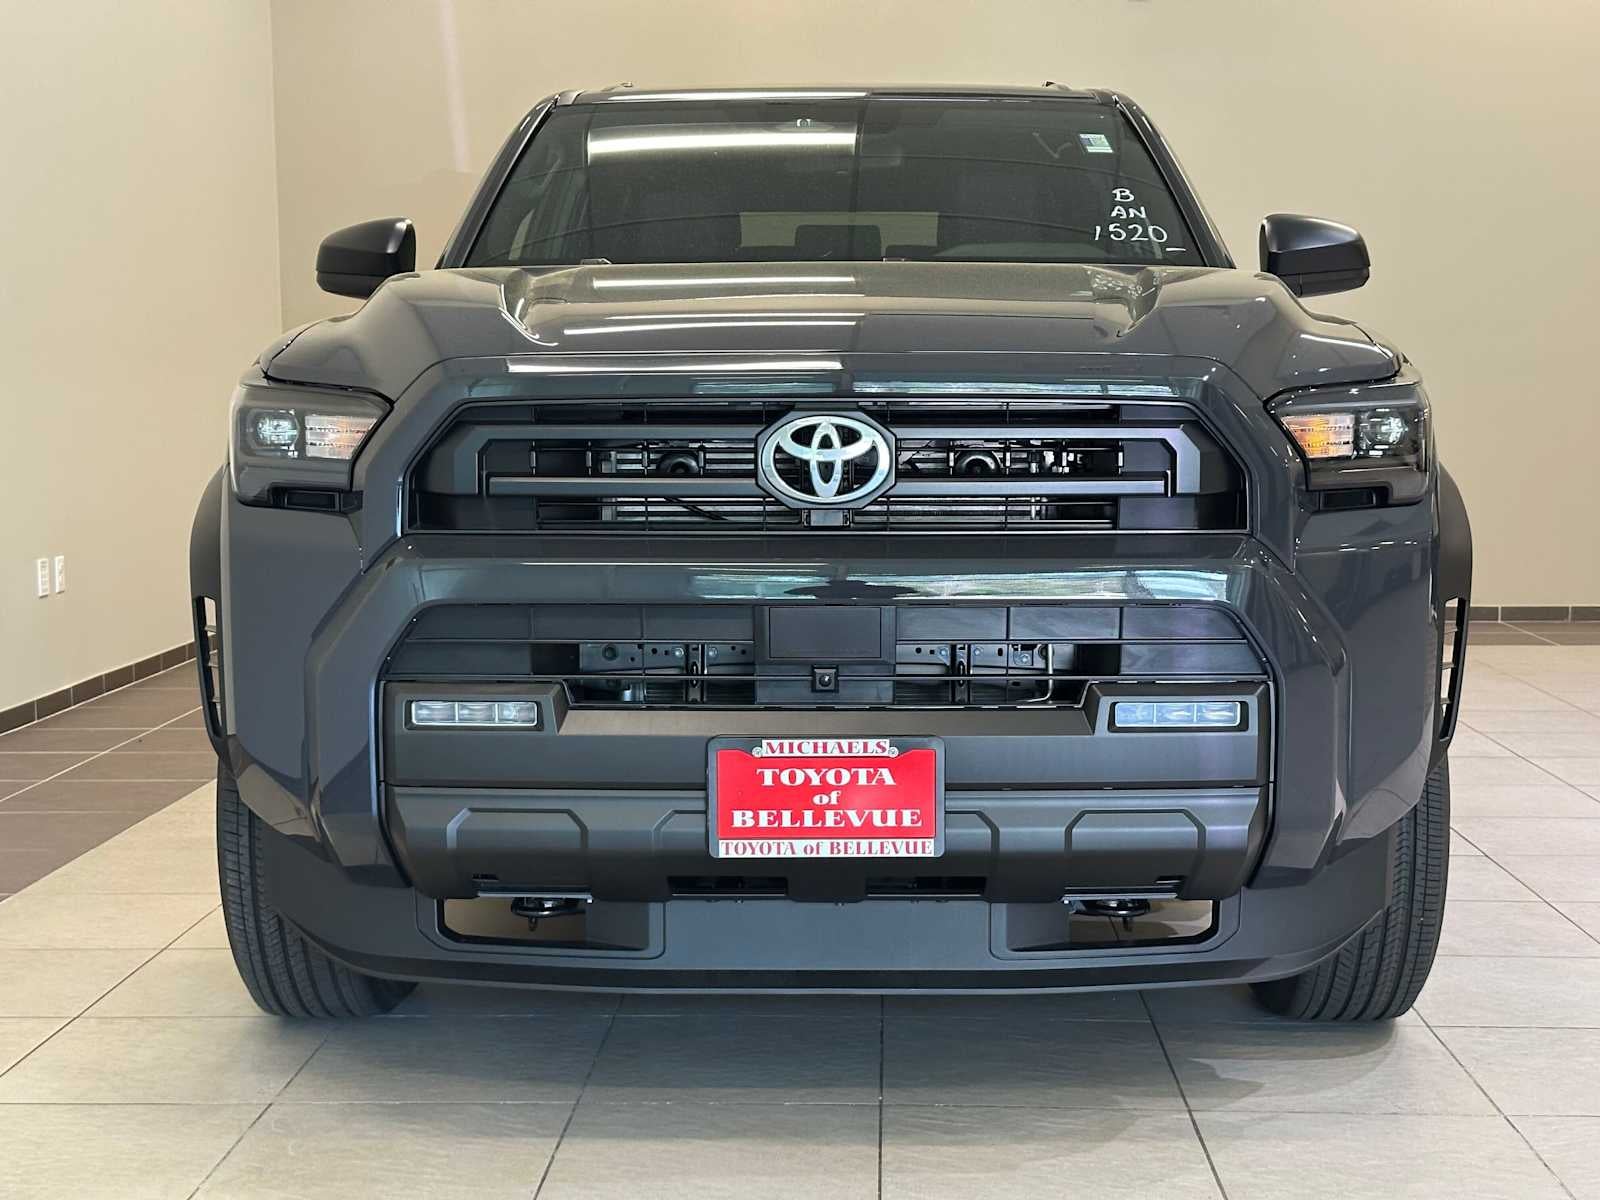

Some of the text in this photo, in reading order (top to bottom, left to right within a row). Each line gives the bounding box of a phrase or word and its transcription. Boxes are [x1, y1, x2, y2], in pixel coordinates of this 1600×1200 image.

[1112, 188, 1135, 202] B
[1110, 205, 1147, 219] AN
[763, 741, 888, 754] MICHAELS
[756, 768, 896, 786] TOYOTA
[812, 791, 842, 805] of
[731, 809, 923, 828] BELLEVUE
[720, 840, 932, 856] TOYOTA of BELLEVUE
